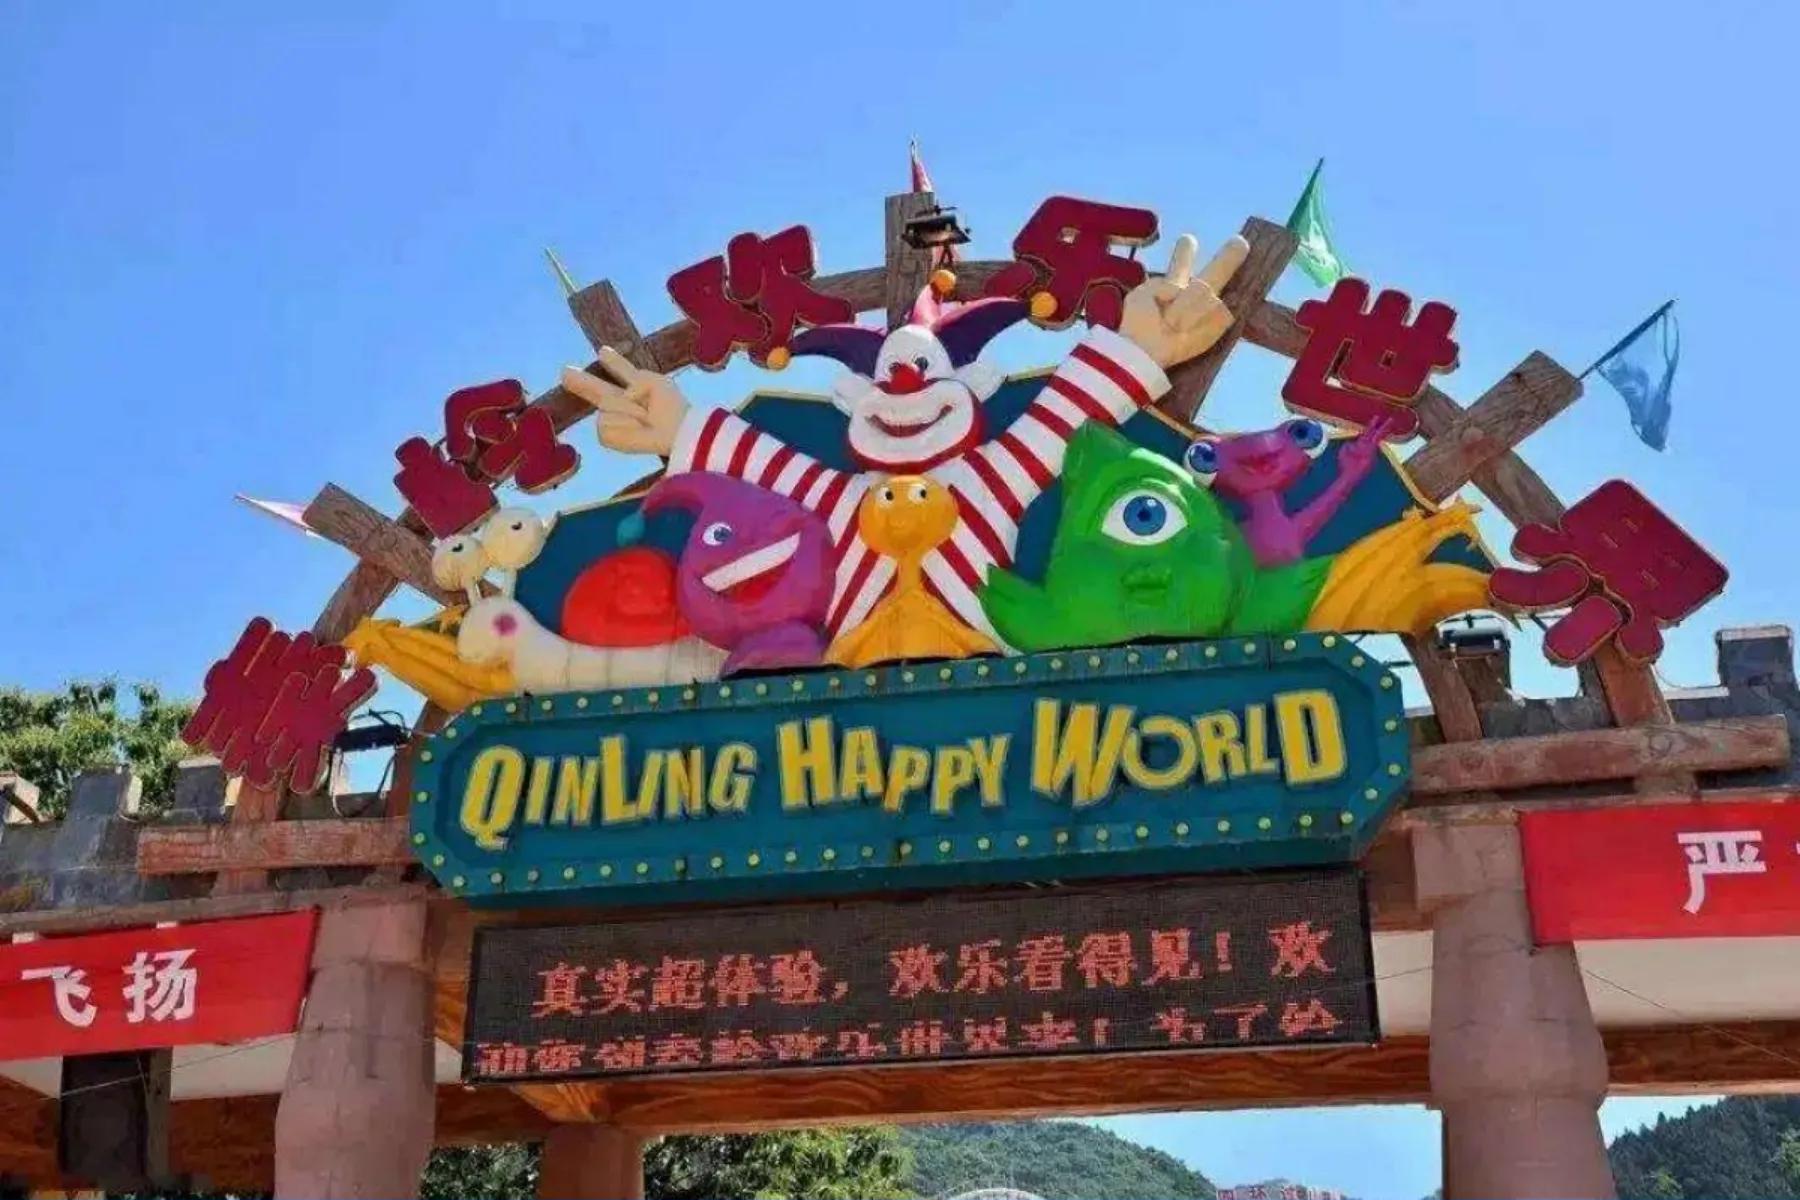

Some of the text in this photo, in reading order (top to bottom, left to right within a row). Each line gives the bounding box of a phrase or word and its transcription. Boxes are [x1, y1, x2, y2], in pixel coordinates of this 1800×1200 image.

[460, 689, 1347, 850] QINLING HAPPY WORLD
[1677, 830, 1800, 914] 严
[21, 948, 198, 1028] 飞扬
